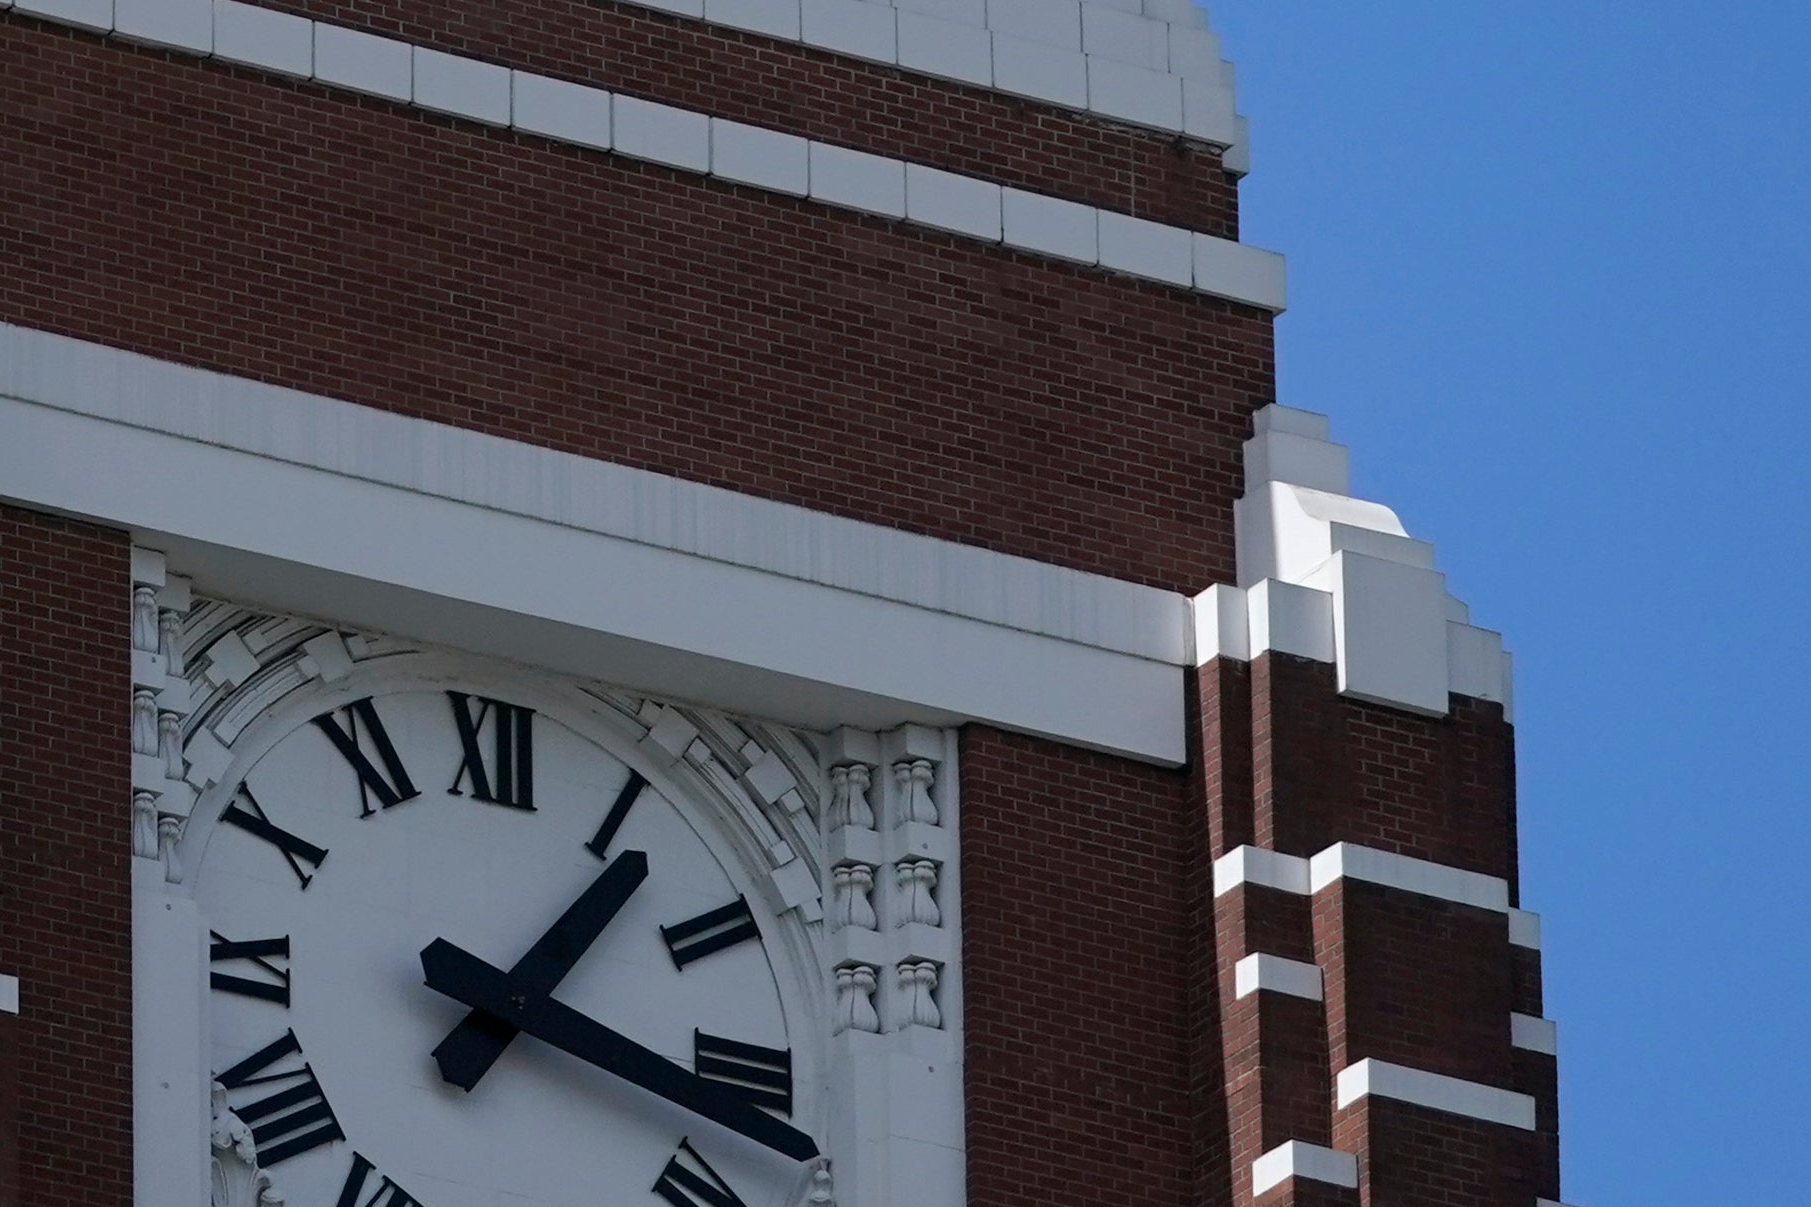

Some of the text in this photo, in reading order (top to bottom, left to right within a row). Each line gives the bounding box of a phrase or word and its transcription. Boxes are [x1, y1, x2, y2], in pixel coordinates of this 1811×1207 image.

[310, 695, 422, 819] XI
[445, 689, 537, 812] XII
[219, 780, 329, 890] X
[585, 767, 651, 861] I
[659, 892, 763, 972] II
